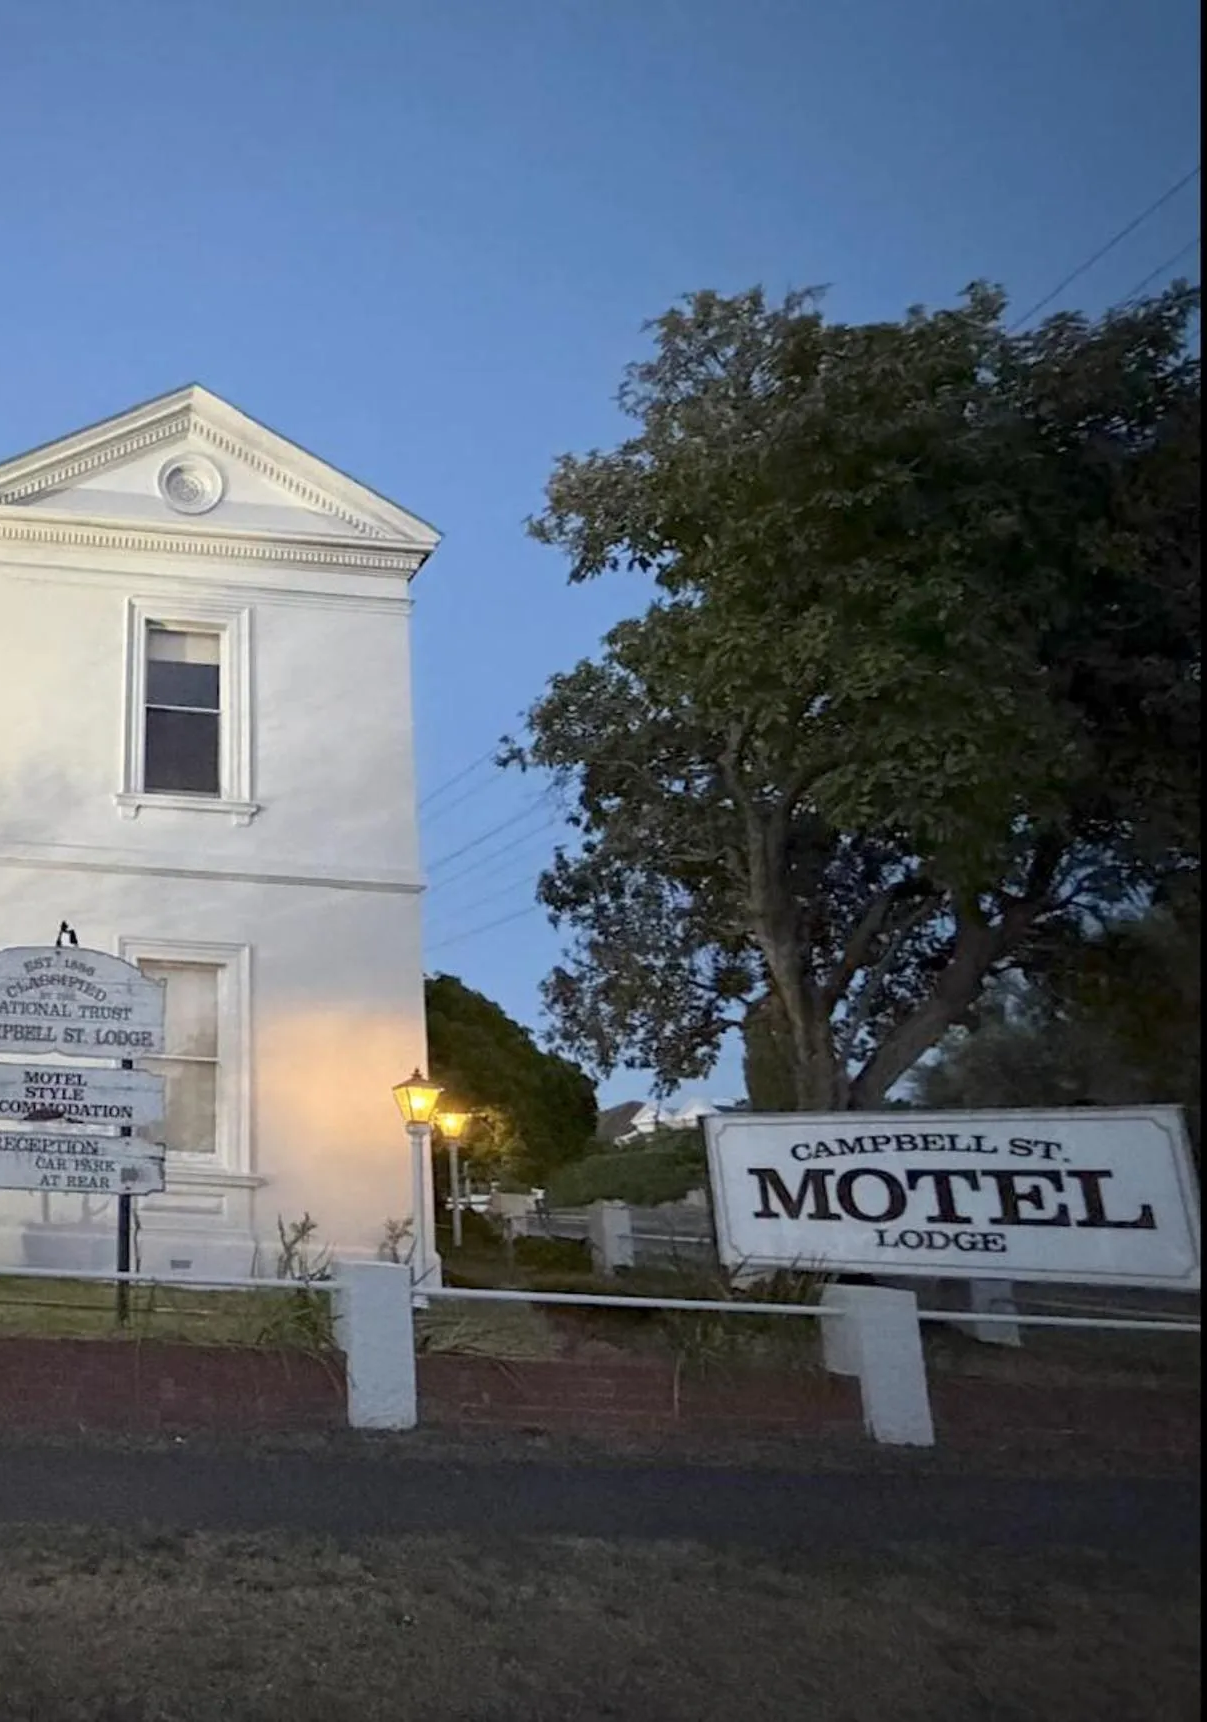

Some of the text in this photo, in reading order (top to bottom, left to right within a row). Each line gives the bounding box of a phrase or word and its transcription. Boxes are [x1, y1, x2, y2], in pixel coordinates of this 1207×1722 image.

[23, 957, 53, 974] EST
[6, 974, 107, 1002] CLASSIFIED
[78, 1004, 133, 1021] TRUST
[63, 1027, 89, 1044] ST.
[96, 1028, 154, 1048] LODGE
[23, 1071, 87, 1087] MOTEL
[25, 1087, 85, 1101] STYLE
[790, 1133, 1072, 1164] CAMPBELL ST.
[35, 1155, 116, 1173] CAR PARK
[40, 1174, 110, 1189] AT REAR
[747, 1167, 1158, 1230] MOTEL
[875, 1228, 1007, 1253] LODGE
